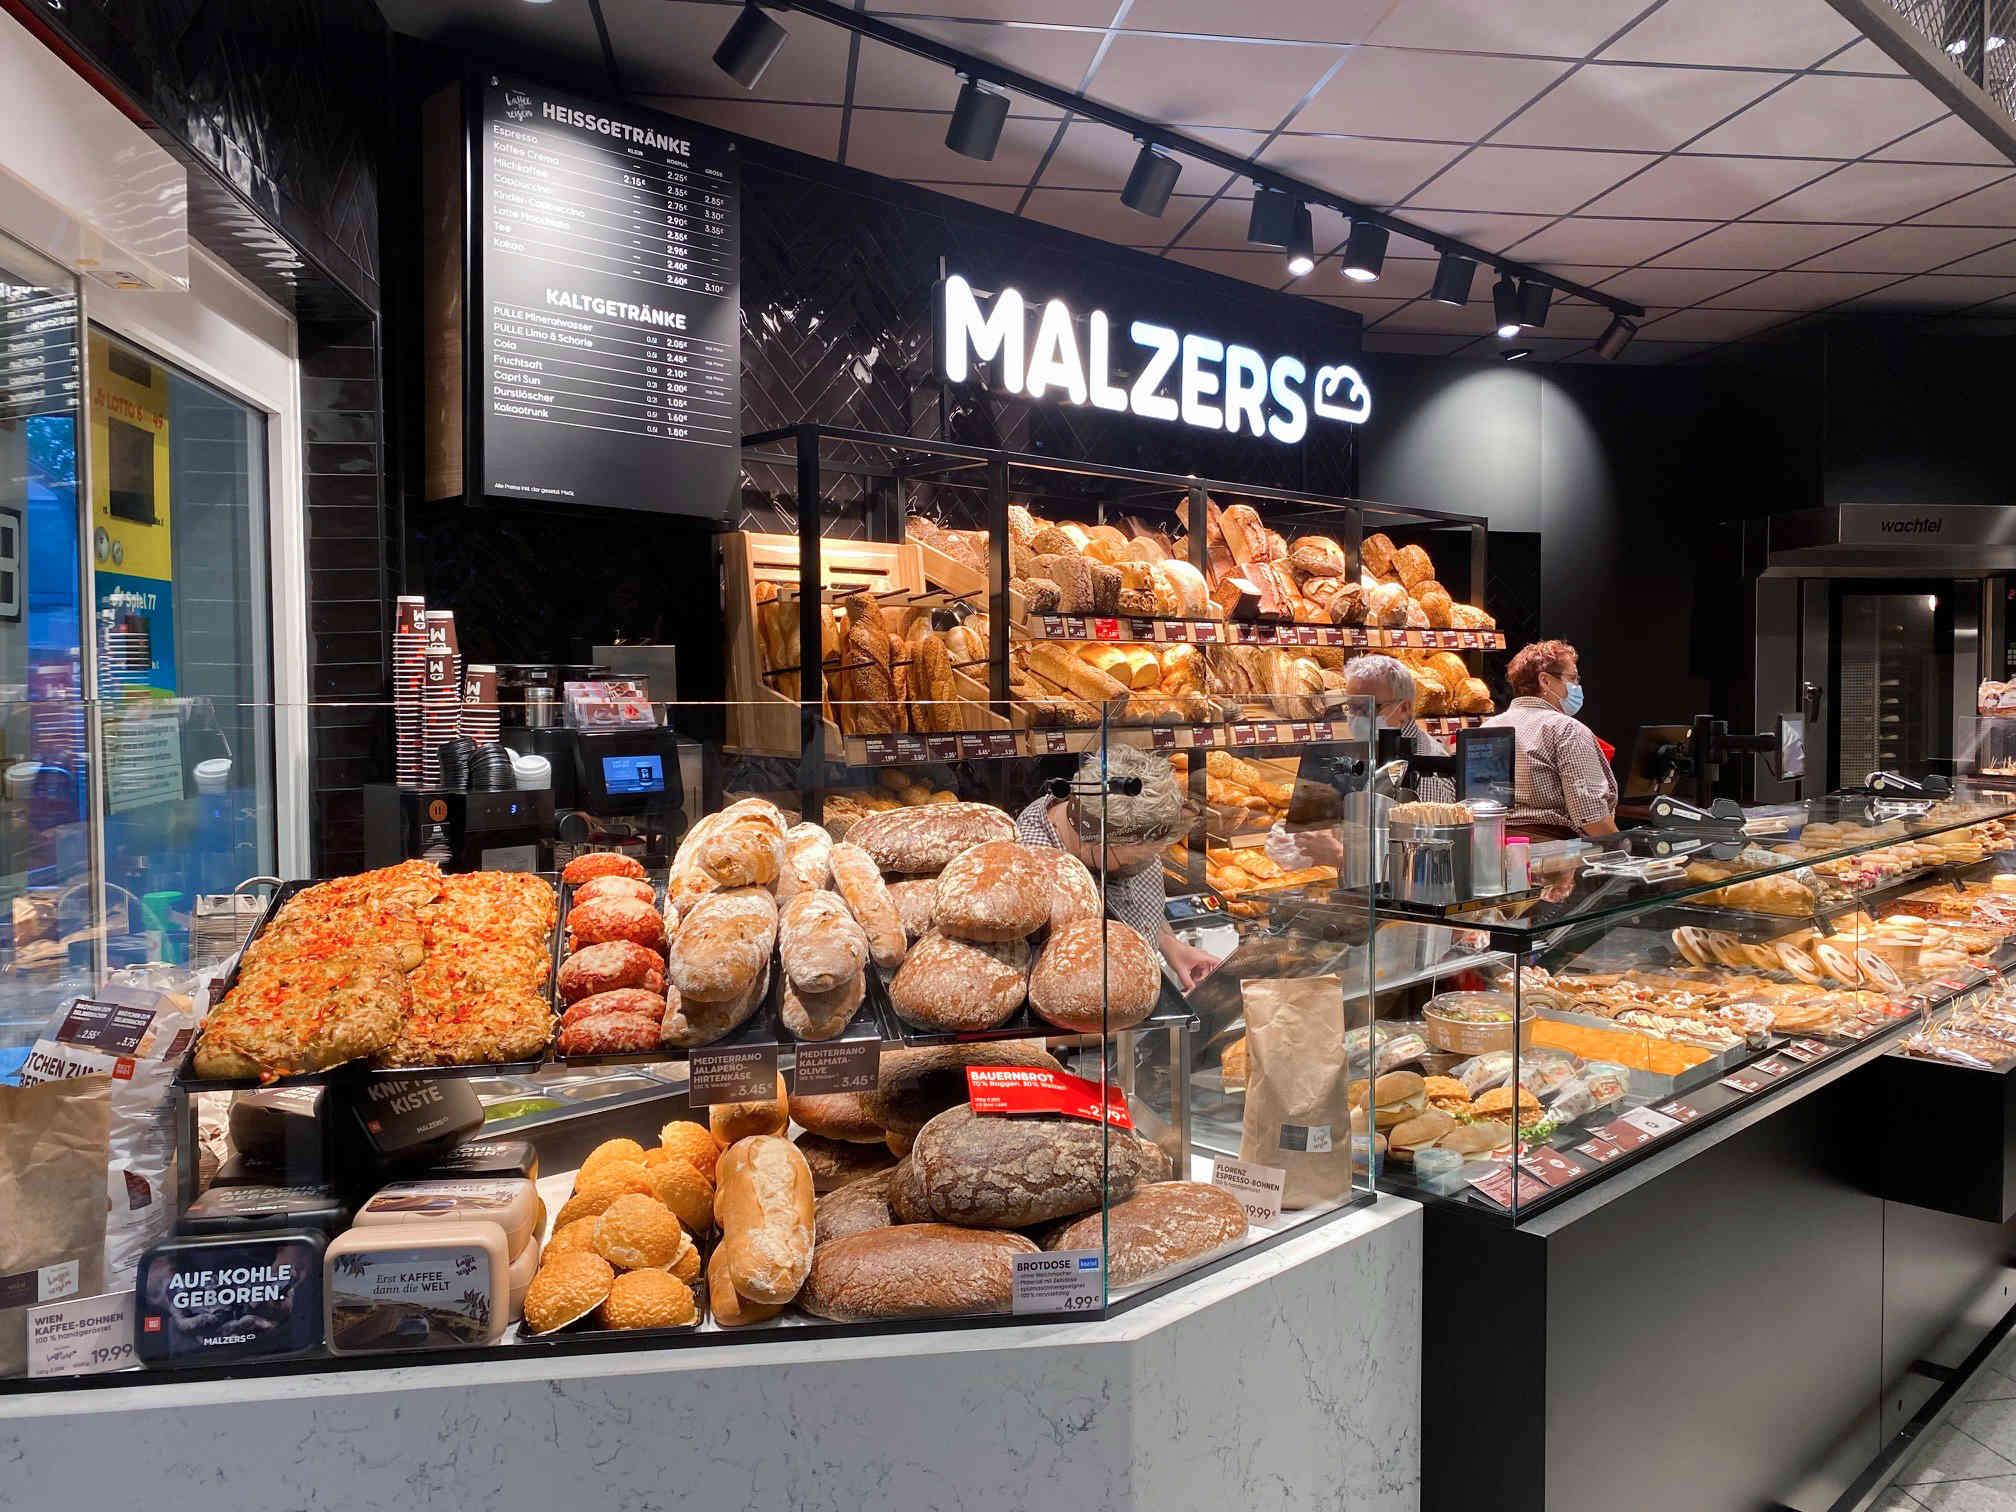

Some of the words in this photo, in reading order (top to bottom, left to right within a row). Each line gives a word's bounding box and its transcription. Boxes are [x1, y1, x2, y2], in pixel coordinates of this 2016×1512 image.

[493, 125, 538, 144] Espresso
[542, 102, 690, 157] HEISSGETRÄNKE
[493, 142, 526, 157] Kaffee
[623, 175, 646, 187] 2.15€
[494, 221, 512, 233] Tee
[494, 238, 525, 252] Kakao
[545, 288, 687, 330] KALTGETRÄNKE
[493, 305, 524, 319] PULLE
[525, 311, 593, 332] Mineralwasser
[493, 322, 524, 336] PULLE
[525, 328, 549, 340] Limo
[558, 333, 593, 348] Schorle
[493, 338, 517, 350] Cola
[493, 354, 544, 370] Fruchtsaft
[944, 274, 1308, 445] MALZERS
[493, 386, 556, 403] Durstlöscher
[493, 401, 550, 418] Kakaotrunk
[1881, 516, 1943, 533] wachtel
[693, 1053, 762, 1065] MEDITERRANO
[800, 1046, 866, 1058] MEDITERRANO
[799, 1057, 852, 1067] KALAMATA-
[693, 1071, 752, 1084] HIRTENKÄSE
[800, 1067, 828, 1076] OLIVE
[970, 1071, 1055, 1083] BAUERNBROT
[390, 1085, 445, 1115] KISTE
[1217, 1164, 1248, 1176] FLORENZ
[1017, 1259, 1071, 1271] BROTDOSE
[169, 1271, 213, 1290] AUF
[218, 1264, 292, 1287] KOHLE
[376, 1274, 397, 1284] Erst
[373, 1284, 400, 1295] dann
[402, 1283, 419, 1294] die
[421, 1281, 451, 1292] WELT
[173, 1284, 285, 1309] GEBOREN.
[35, 1313, 64, 1326] WIEN
[35, 1311, 124, 1336] KAFFEE-BOHNEN
[203, 1334, 246, 1346] MALZERS
[91, 1343, 133, 1364] 19.99
